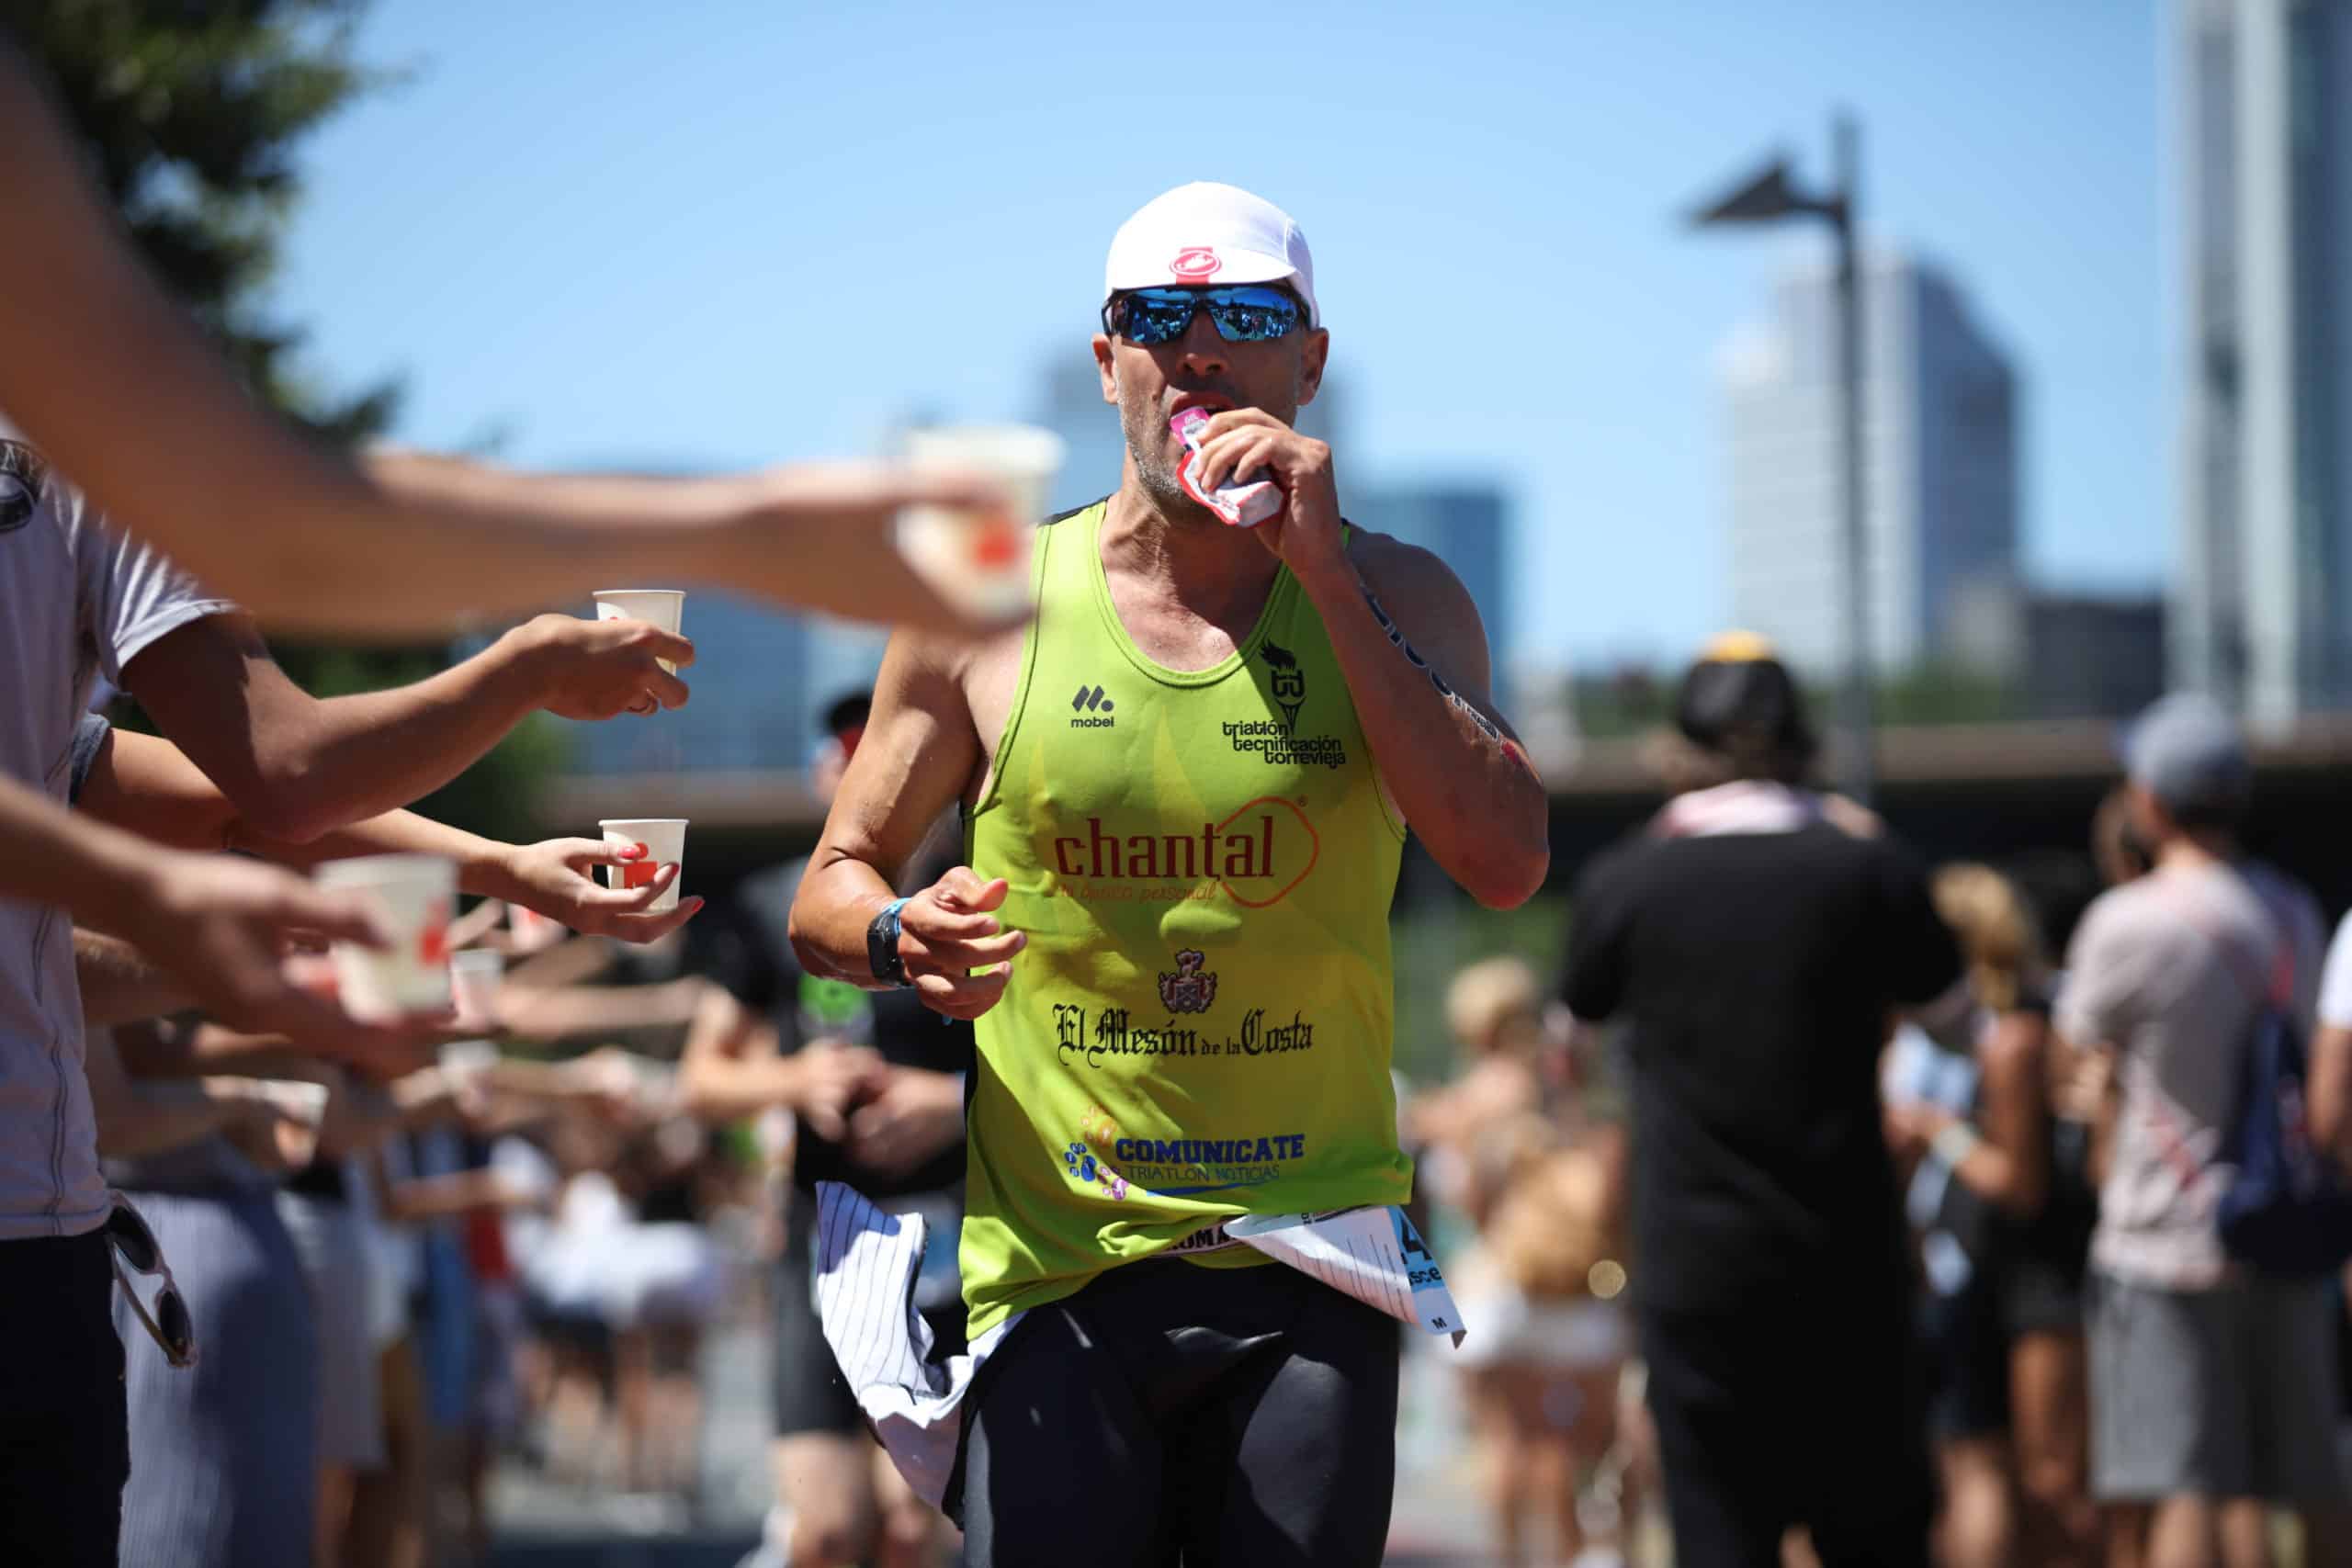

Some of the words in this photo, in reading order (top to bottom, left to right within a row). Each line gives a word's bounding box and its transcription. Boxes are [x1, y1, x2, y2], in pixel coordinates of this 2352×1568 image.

[1070, 716, 1114, 728] mobel
[1222, 720, 1288, 737] triatlón
[1232, 735, 1341, 751] tecnificación
[1264, 750, 1346, 769] torrevieja
[1055, 816, 1274, 881] chantal
[1053, 1004, 1086, 1066] El
[1087, 1008, 1197, 1068] Mesón
[1201, 1039, 1220, 1055] de
[1227, 1037, 1241, 1055] la
[1241, 1008, 1314, 1056] Costa
[1115, 1134, 1305, 1164] COMUNICATE
